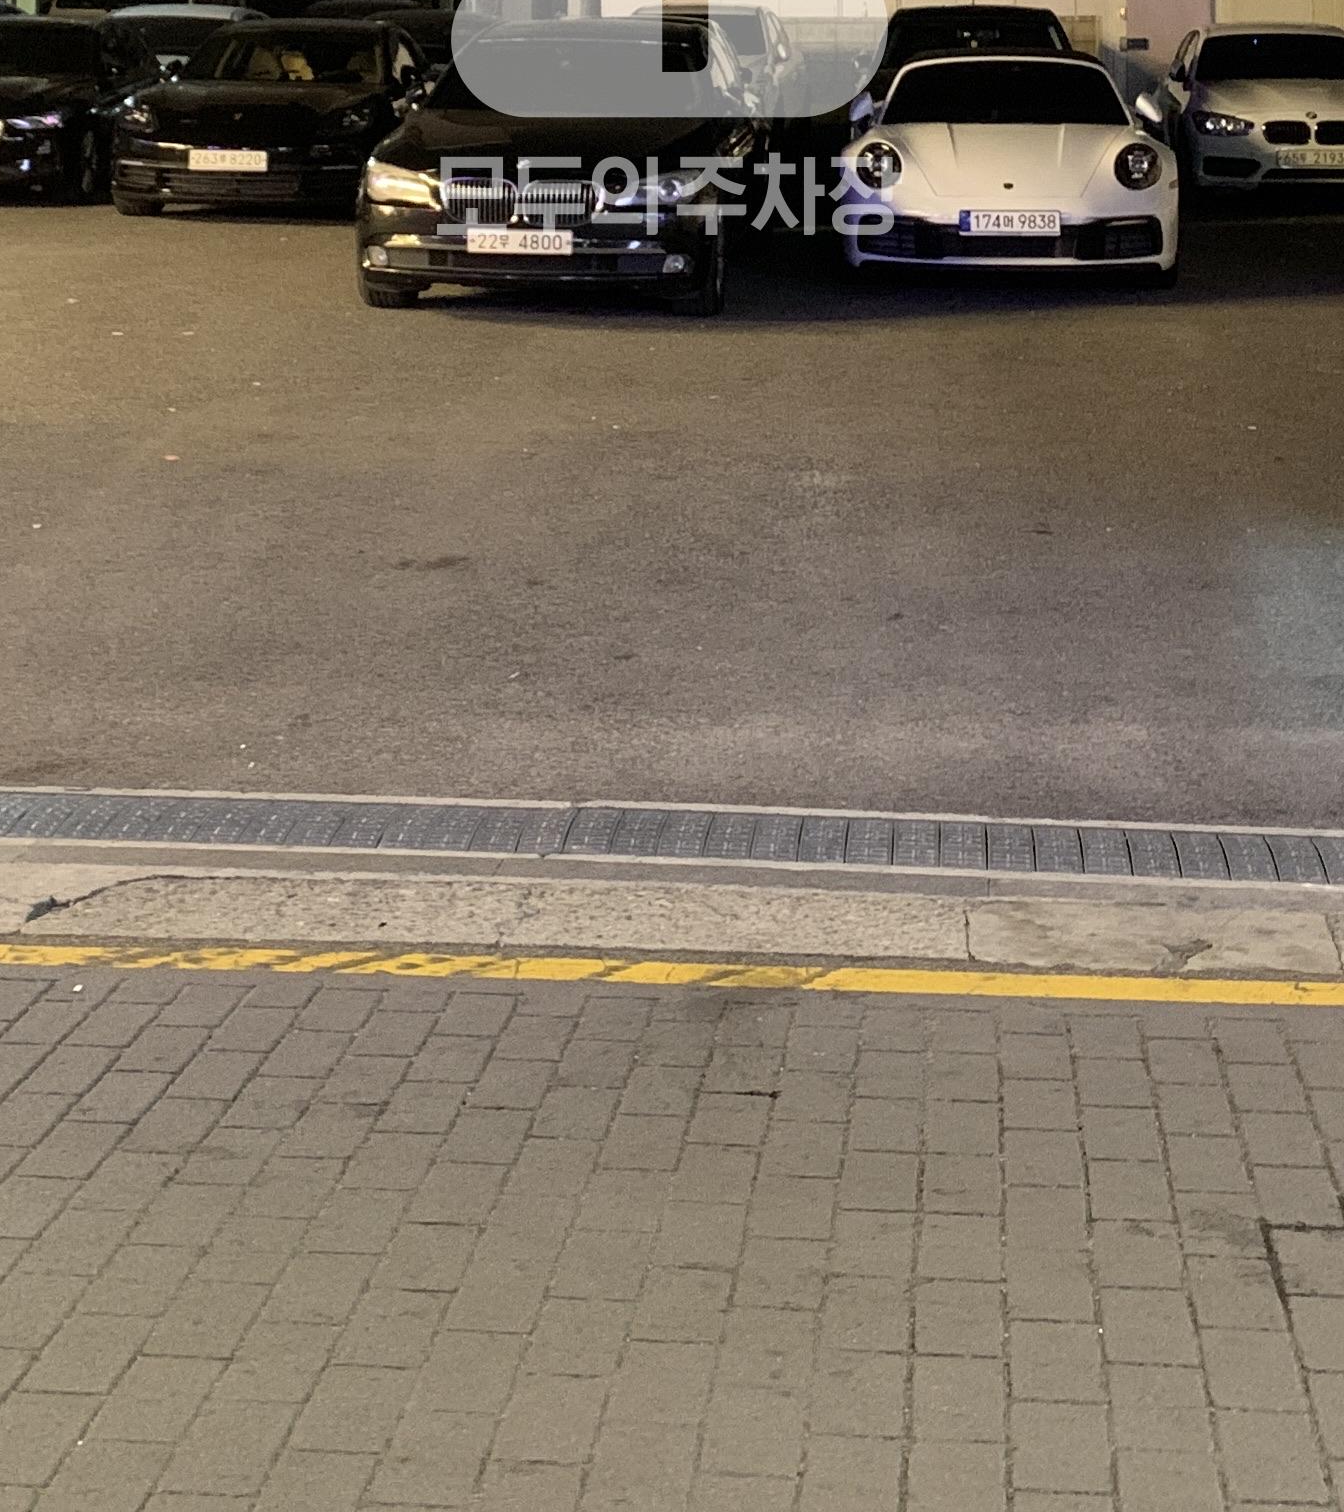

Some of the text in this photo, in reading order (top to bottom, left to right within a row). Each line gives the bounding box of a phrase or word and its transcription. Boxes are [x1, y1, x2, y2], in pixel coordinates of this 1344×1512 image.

[230, 152, 262, 166] 8220
[1312, 152, 1344, 164] 2193
[1018, 214, 1056, 229] 9838
[518, 234, 563, 250] 4800
